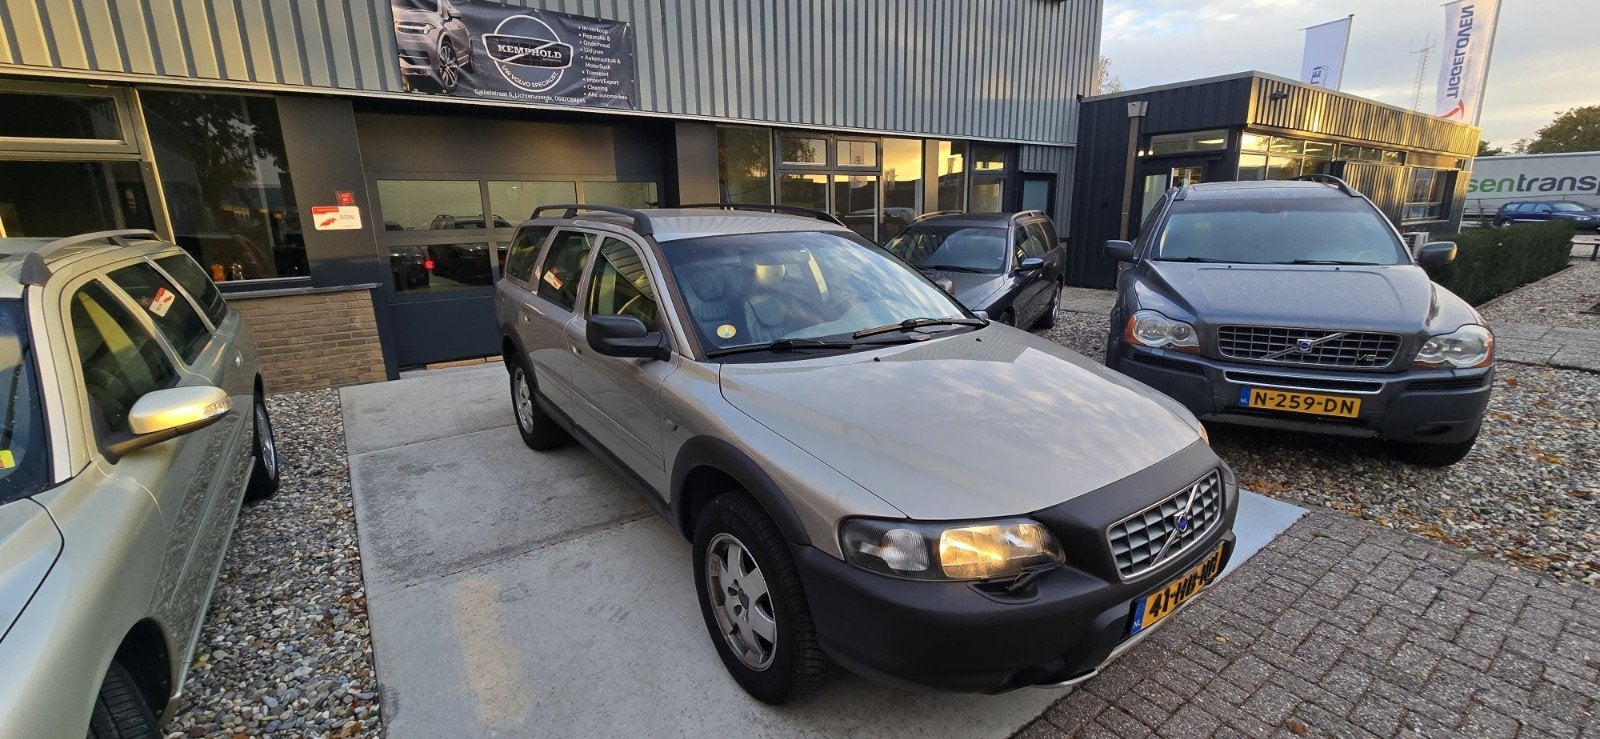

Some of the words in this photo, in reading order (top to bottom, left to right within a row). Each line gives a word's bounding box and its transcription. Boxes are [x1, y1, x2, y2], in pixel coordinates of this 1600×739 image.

[497, 44, 562, 59] KEMPHOLD
[511, 74, 531, 87] VOLVO
[1466, 173, 1600, 197] sentrans
[1254, 391, 1355, 415] N-259-DN
